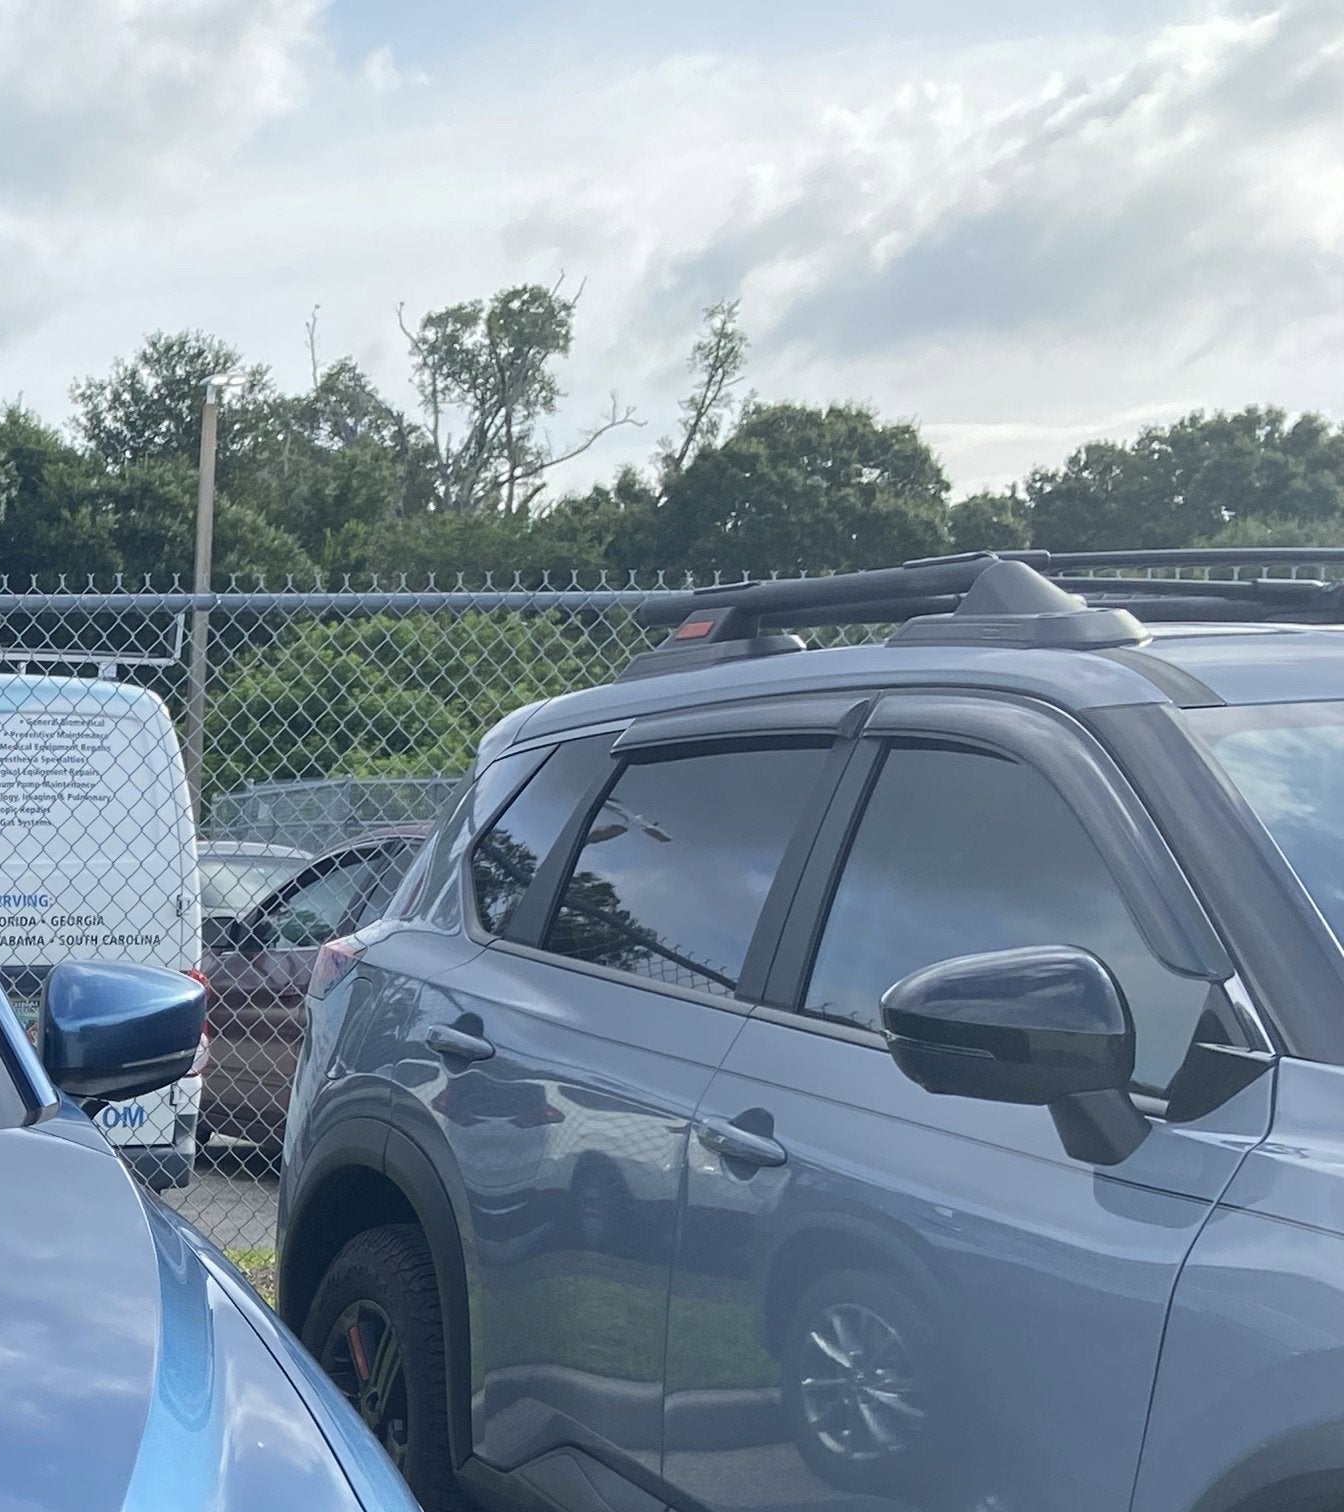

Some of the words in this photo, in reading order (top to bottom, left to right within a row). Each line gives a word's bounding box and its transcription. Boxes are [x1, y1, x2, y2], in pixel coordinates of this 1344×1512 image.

[26, 718, 58, 726] General
[62, 718, 105, 727] Biomedical
[10, 731, 54, 739] Preventive
[57, 731, 109, 740] Maintenance
[0, 743, 32, 751] Medical
[34, 743, 79, 753] Equipment
[81, 744, 111, 753] Repairs
[69, 768, 100, 778] Repairs
[16, 781, 40, 790] Pump
[42, 780, 96, 788] Maintenance
[22, 793, 56, 802] Imaging
[67, 794, 112, 803] Pulmonary
[0, 819, 15, 827] Gas
[18, 819, 52, 828] Systems
[50, 916, 104, 926] GEORGIA
[59, 935, 98, 946] SOUTH
[102, 934, 161, 946] CAROLINA
[102, 1106, 145, 1129] OM
